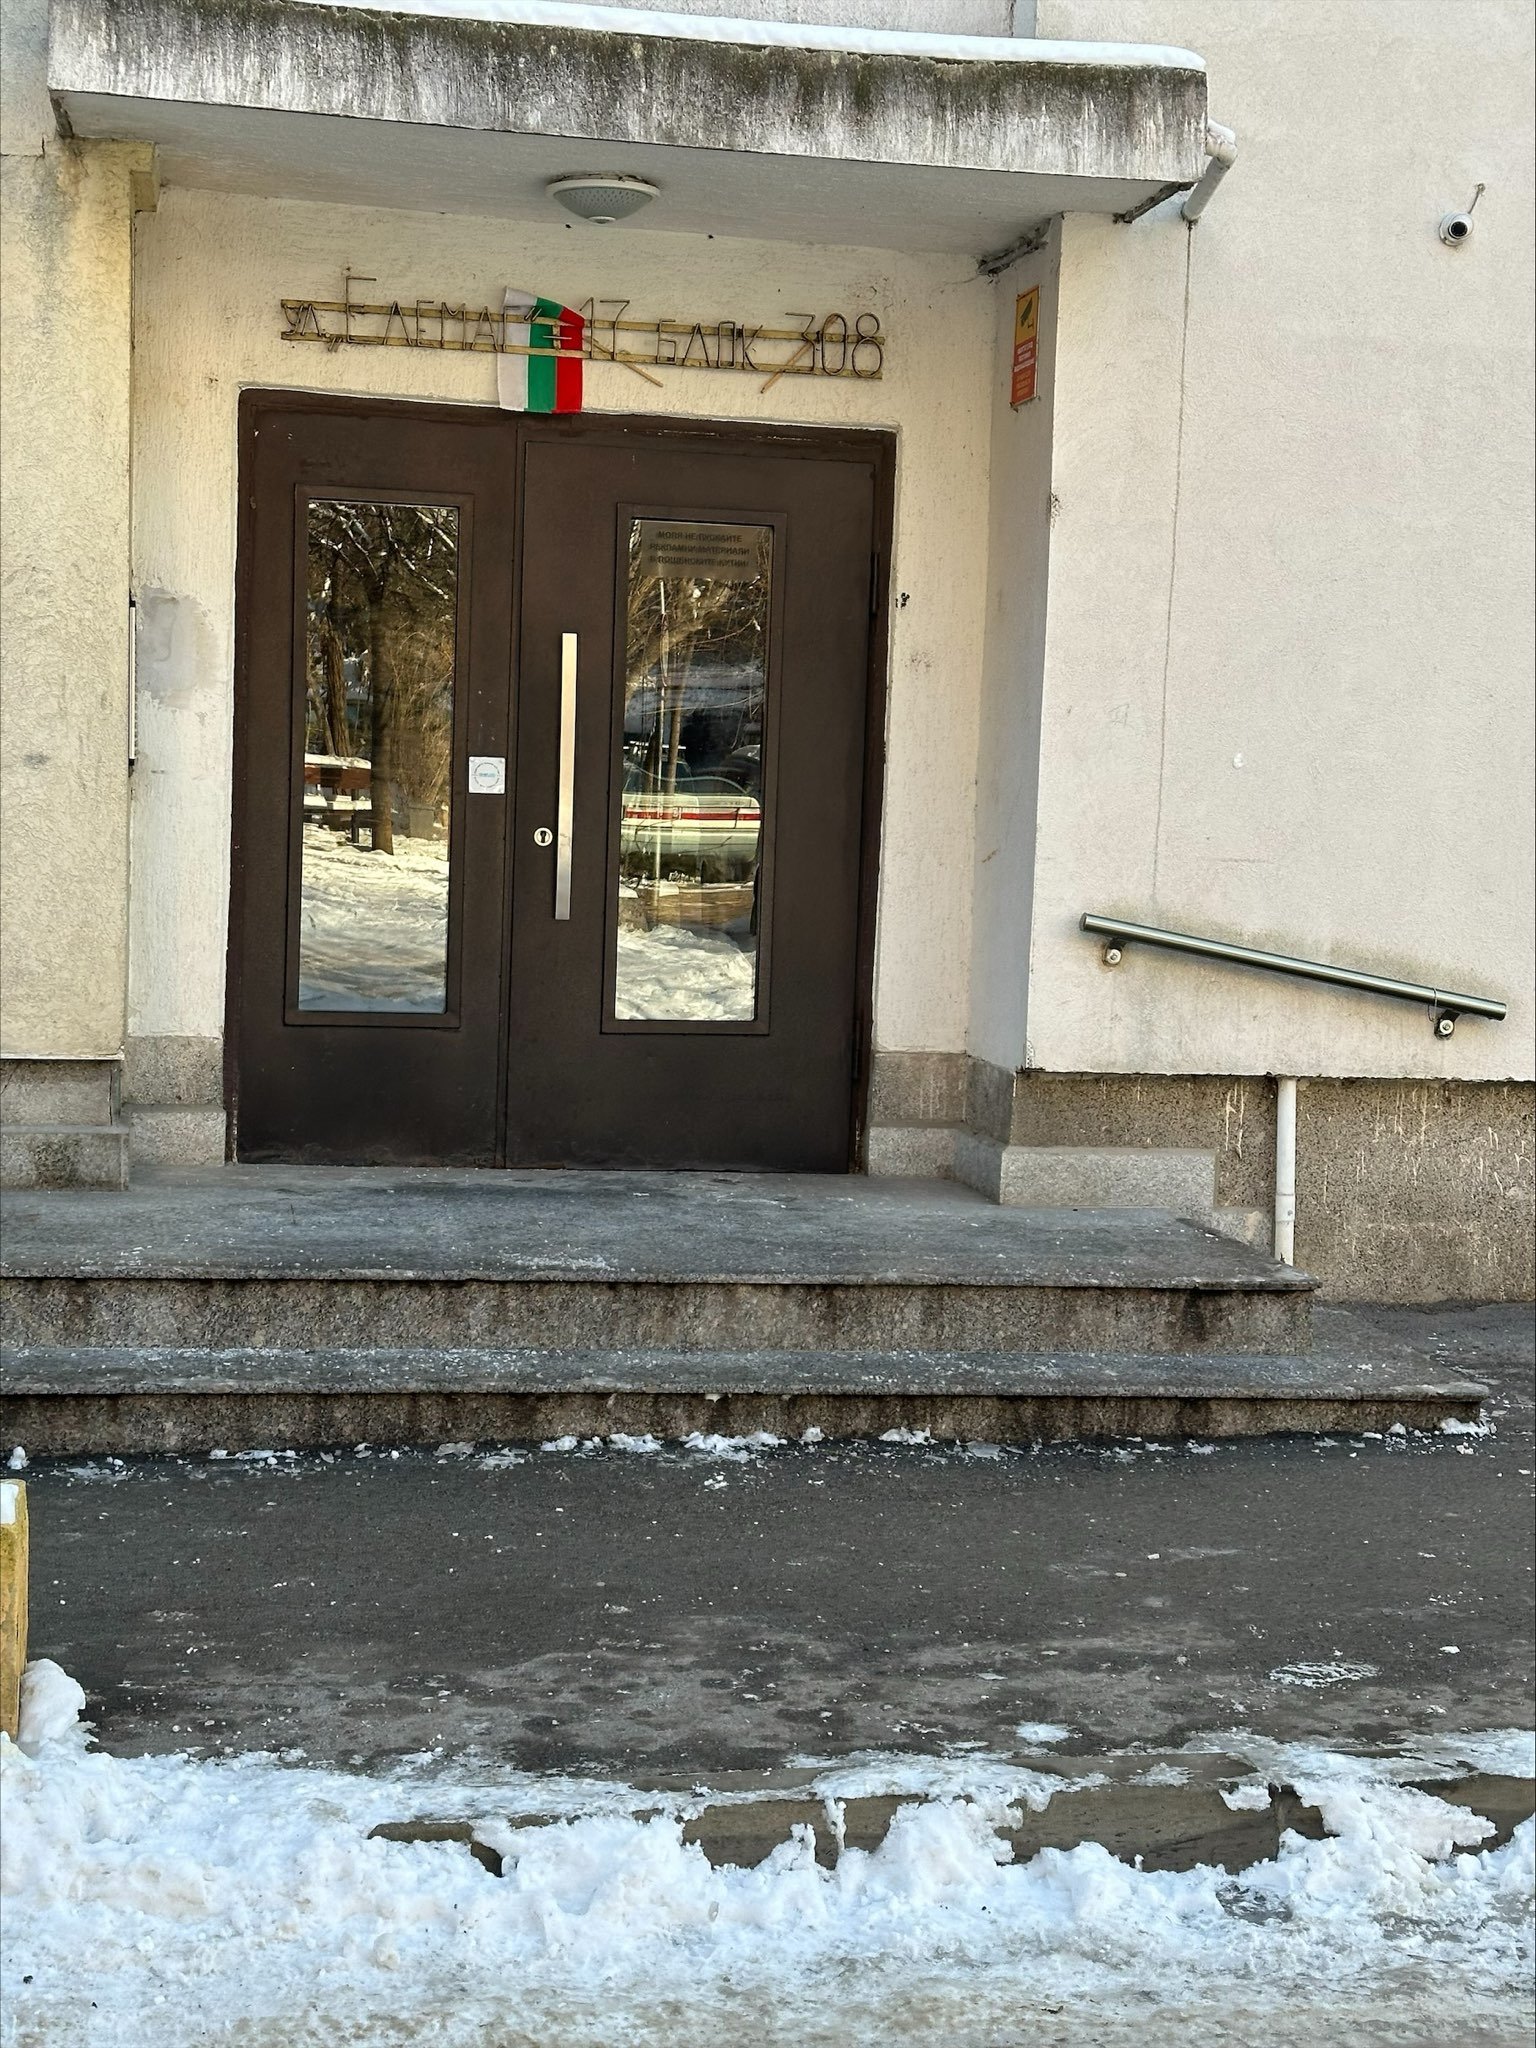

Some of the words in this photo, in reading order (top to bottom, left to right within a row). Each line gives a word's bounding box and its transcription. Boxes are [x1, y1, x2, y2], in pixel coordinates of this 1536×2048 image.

[579, 296, 630, 360] 17
[656, 318, 763, 371] БЛОК
[785, 312, 883, 378] 308
[685, 532, 697, 541] НЕ
